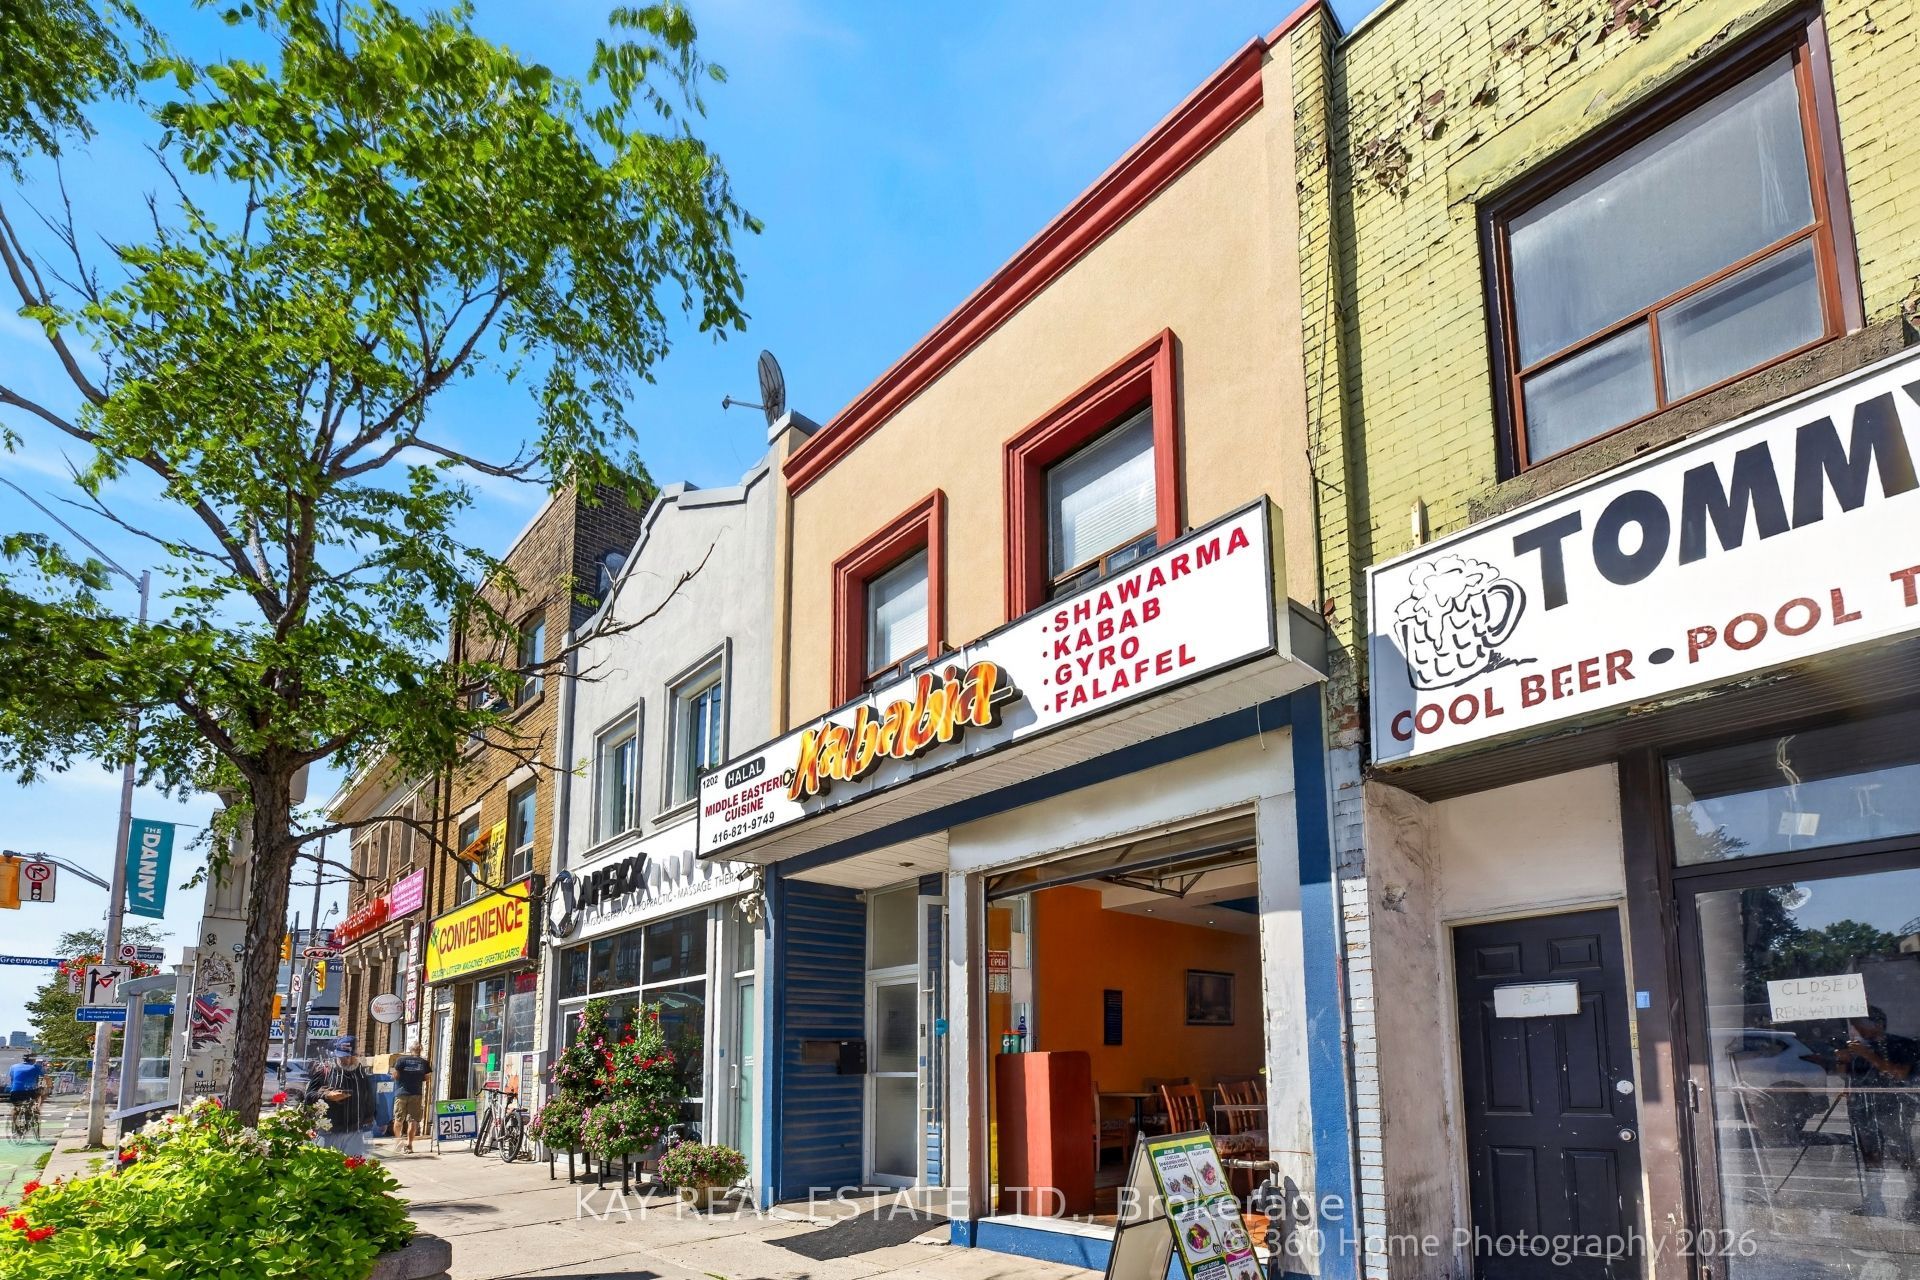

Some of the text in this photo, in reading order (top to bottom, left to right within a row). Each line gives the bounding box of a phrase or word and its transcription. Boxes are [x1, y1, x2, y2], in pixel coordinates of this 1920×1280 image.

[1513, 378, 1920, 611] TOMM
[1054, 526, 1250, 633] SHAWARMA
[1054, 597, 1161, 660] KABAB
[1055, 636, 1140, 685] GYRO
[1055, 643, 1196, 713] FALAFEL
[1391, 685, 1504, 741] COOL
[1521, 648, 1635, 709] BEER
[1686, 587, 1862, 664] POOL
[784, 660, 1022, 802] Kababia
[702, 775, 719, 789] 1202
[727, 760, 763, 787] HALAL
[705, 794, 738, 817] MIDDLE
[712, 811, 775, 844] 416-821-9749
[724, 797, 764, 822] CUISINE
[138, 833, 161, 902] DANNY
[677, 879, 712, 899] MASSAGE
[439, 900, 524, 955] CONVENIENCE
[0, 956, 49, 965] Greenwood
[1781, 978, 1858, 995] CLOSED
